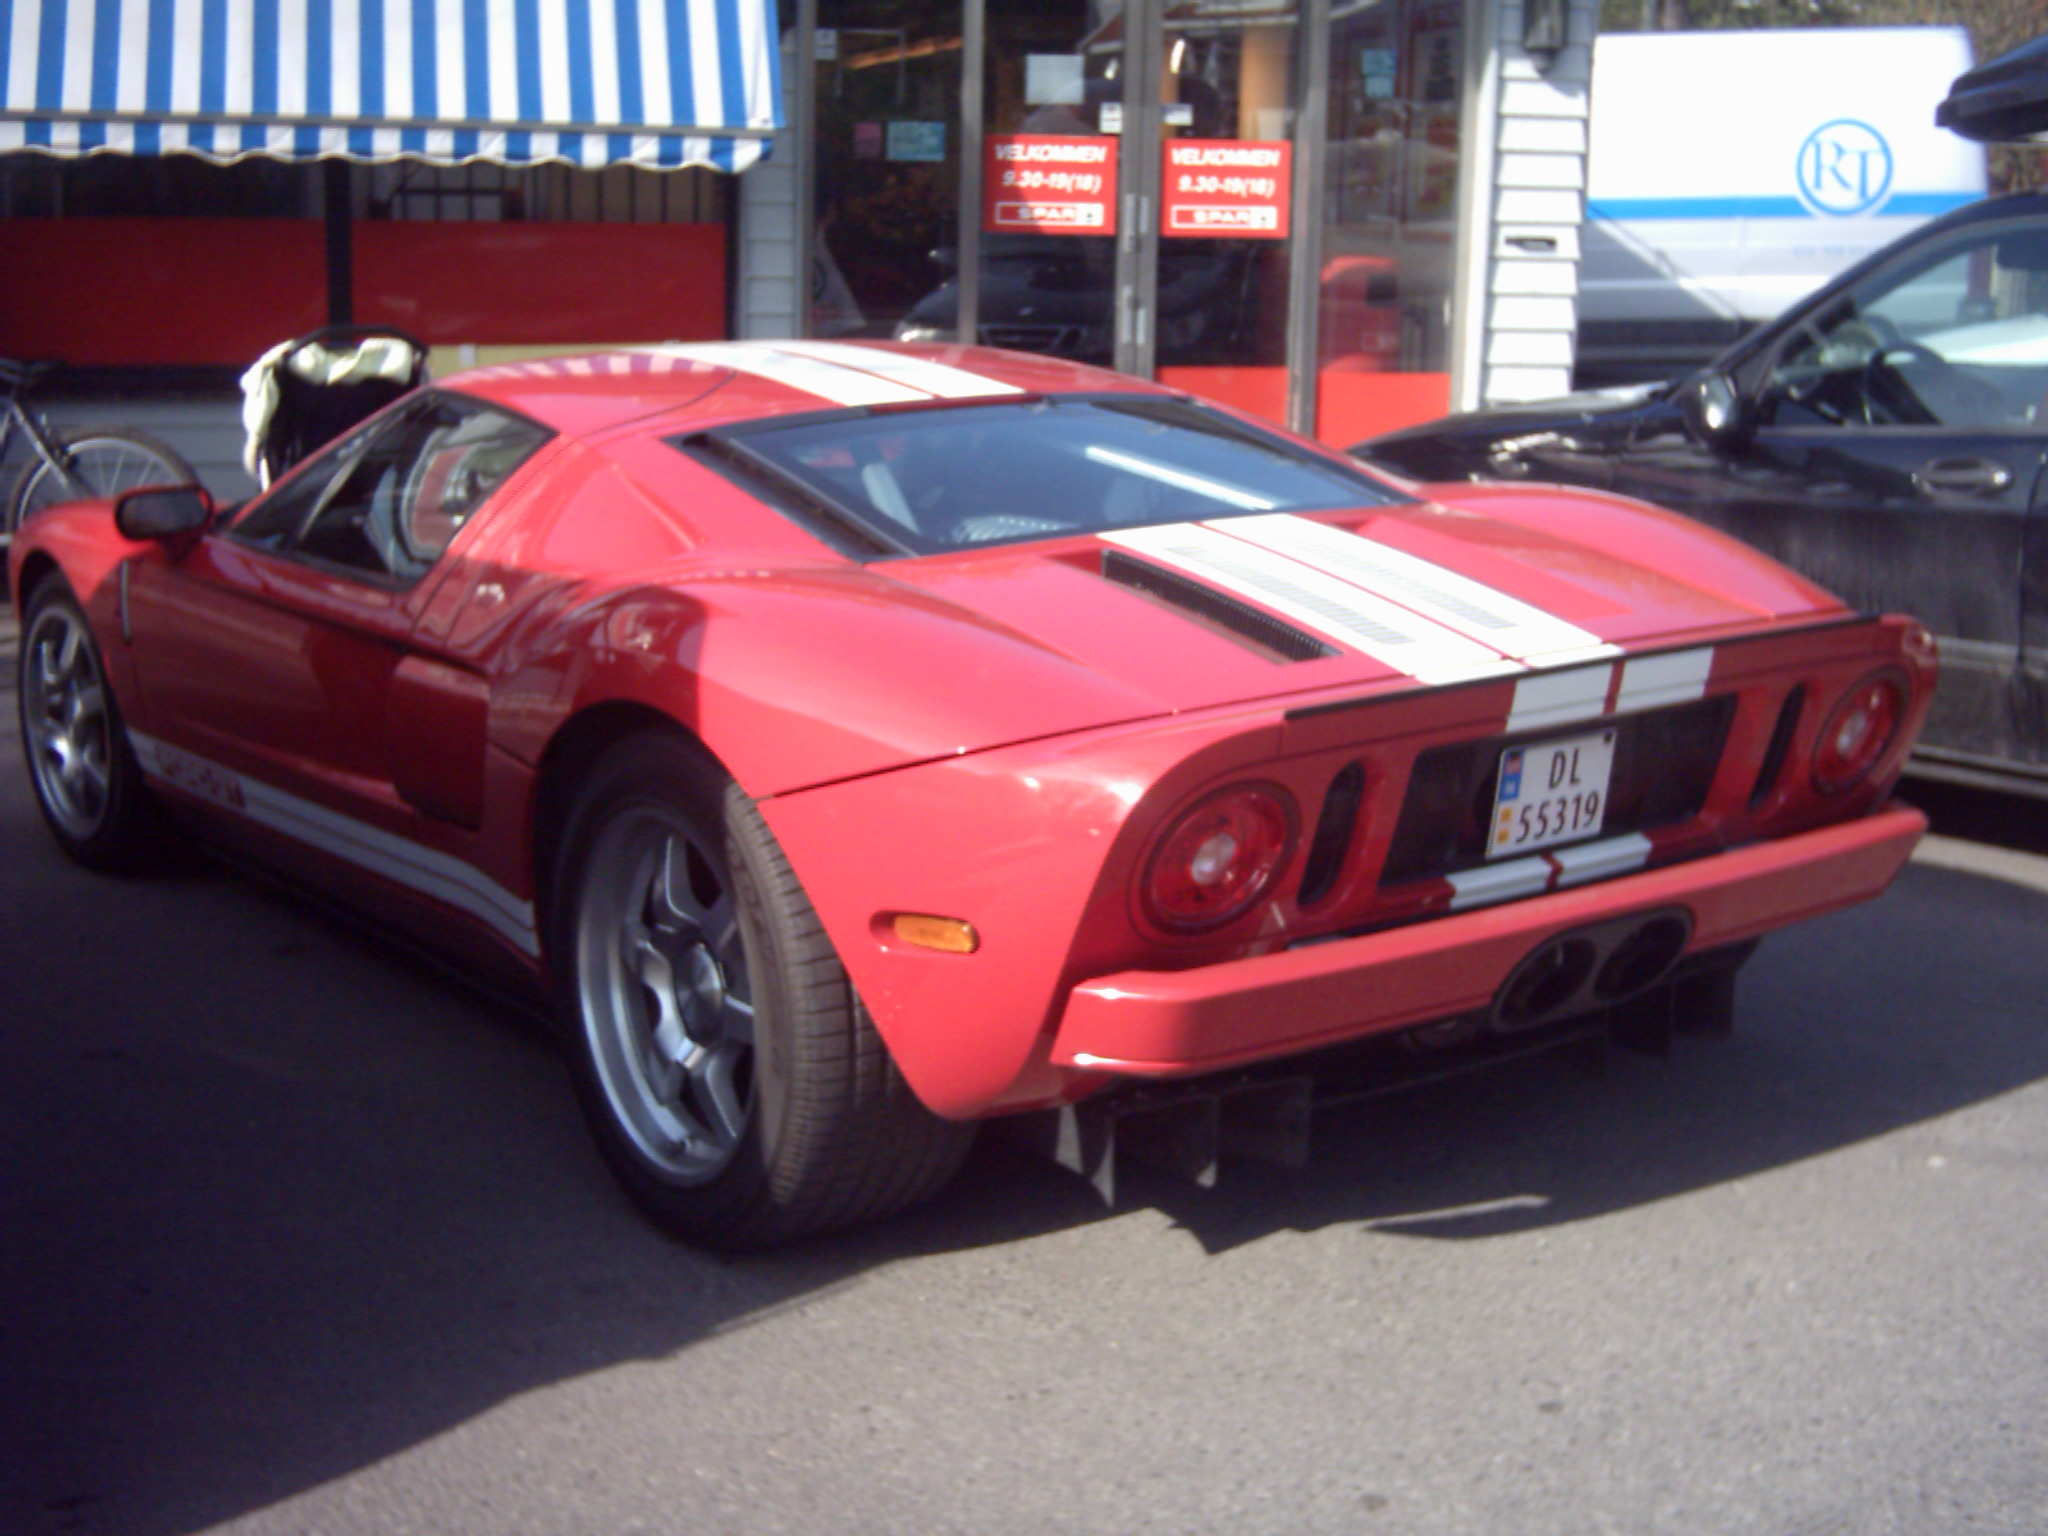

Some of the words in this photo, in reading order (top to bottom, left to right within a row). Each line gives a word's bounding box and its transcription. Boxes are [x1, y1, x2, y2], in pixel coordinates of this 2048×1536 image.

[995, 143, 1107, 162] VELKOMMEN
[1171, 148, 1281, 167] VELKOMMEN
[1018, 207, 1076, 219] SPAR
[1193, 210, 1250, 223] SPAR
[1549, 748, 1581, 788] DL
[1515, 790, 1599, 843] 55319
